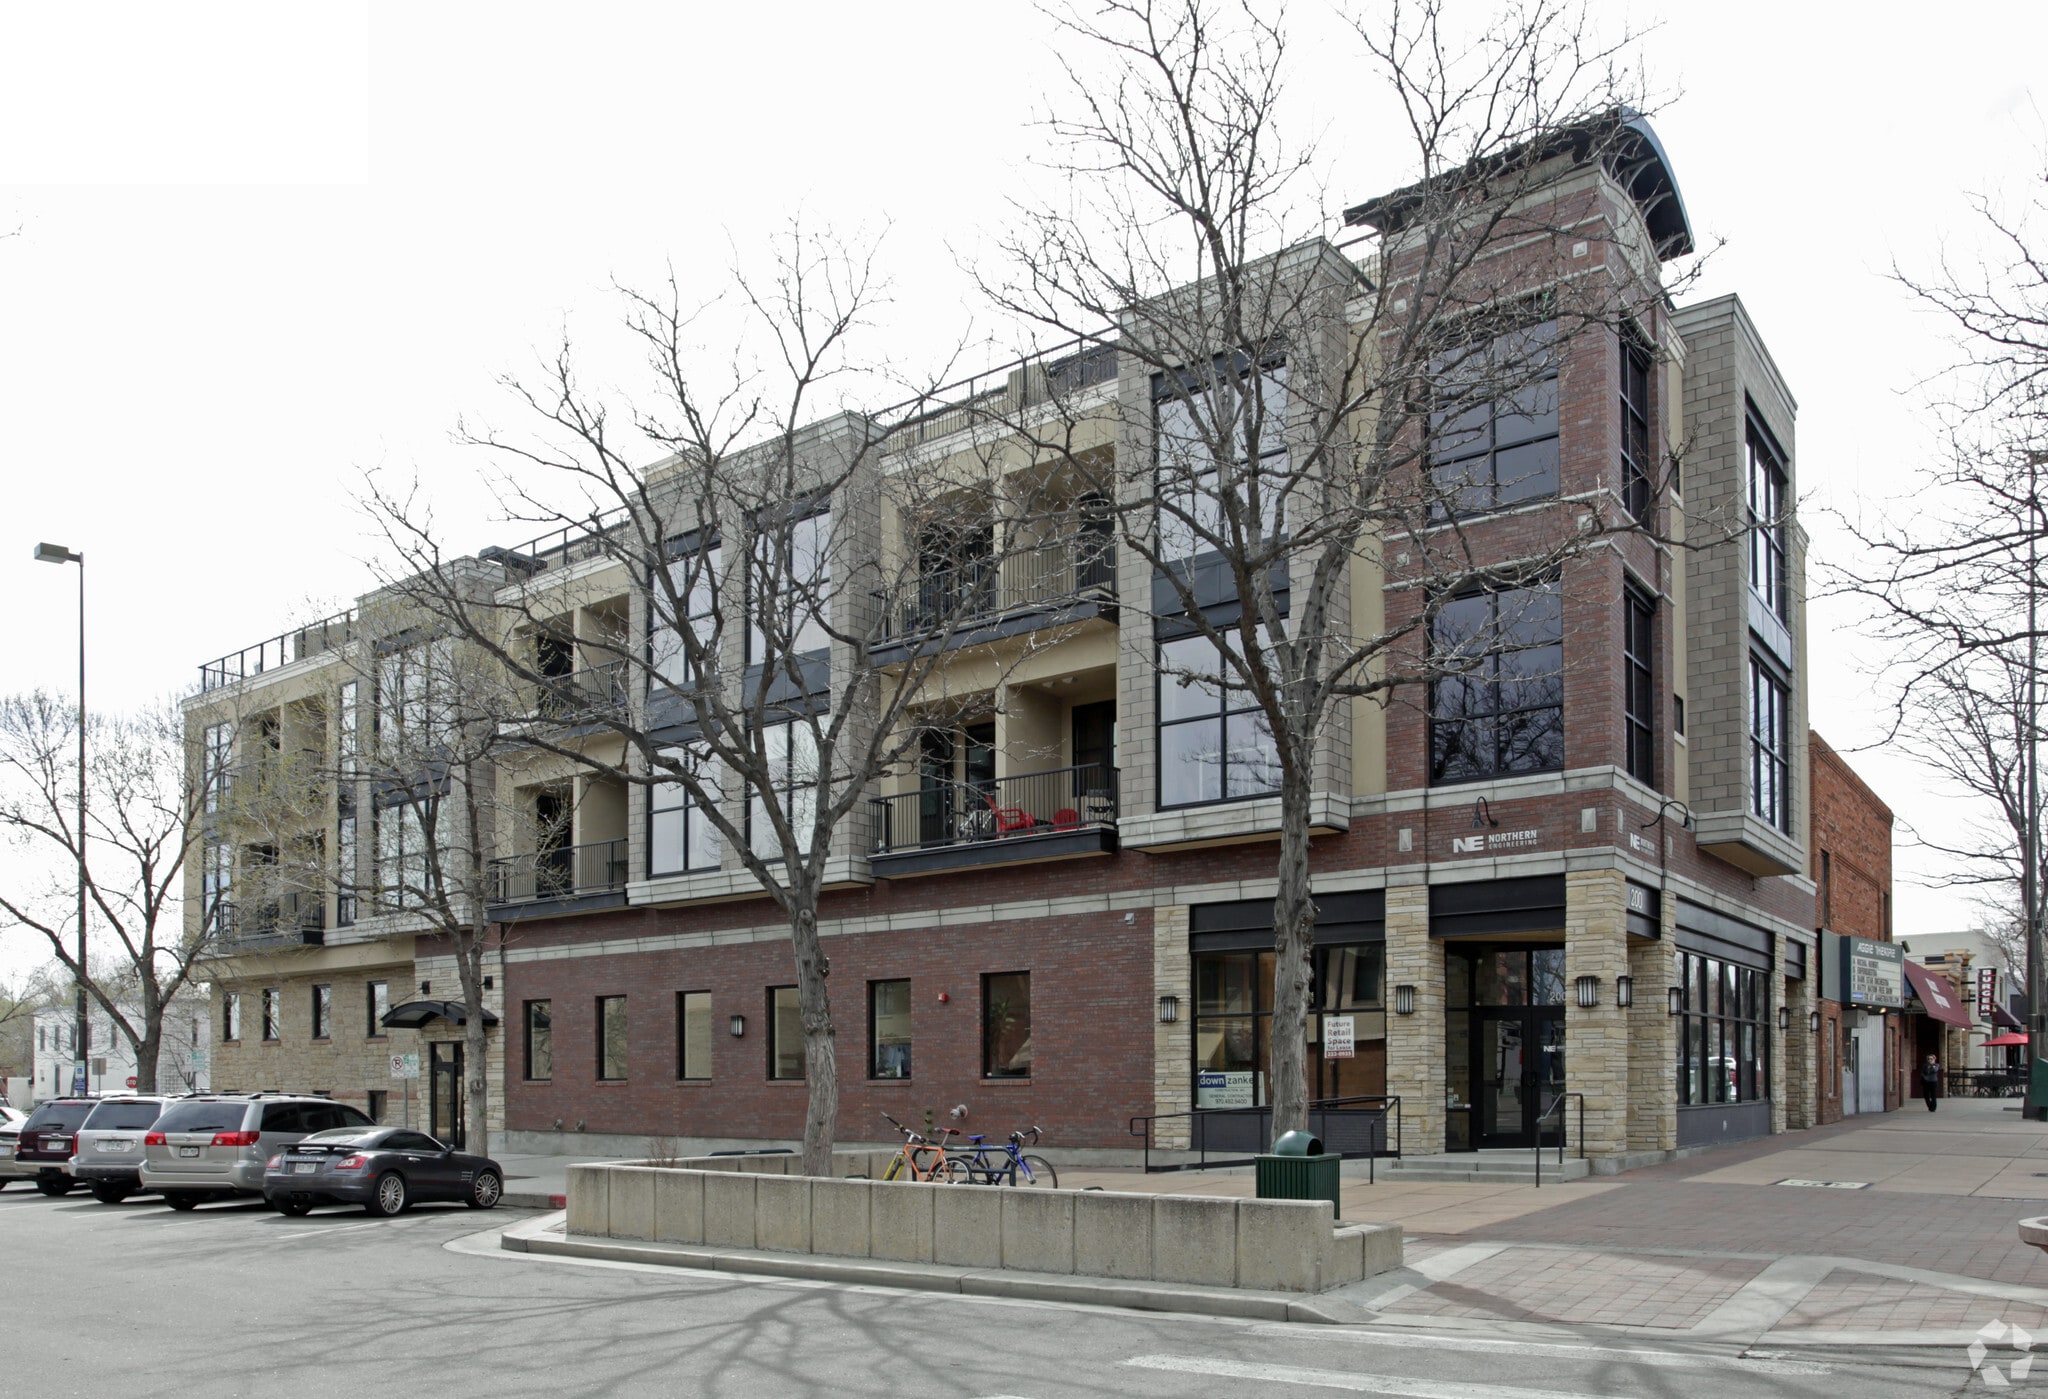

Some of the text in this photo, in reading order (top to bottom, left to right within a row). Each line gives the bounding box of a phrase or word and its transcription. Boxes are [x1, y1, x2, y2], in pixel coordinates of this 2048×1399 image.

[1488, 830, 1537, 843] NORTHERN
[1453, 835, 1484, 853] NE
[1489, 839, 1537, 849] ENGINEERING
[1630, 888, 1643, 909] 200
[1327, 1028, 1351, 1036] Retail
[1327, 1038, 1352, 1046] Space
[1199, 1076, 1225, 1085] down
